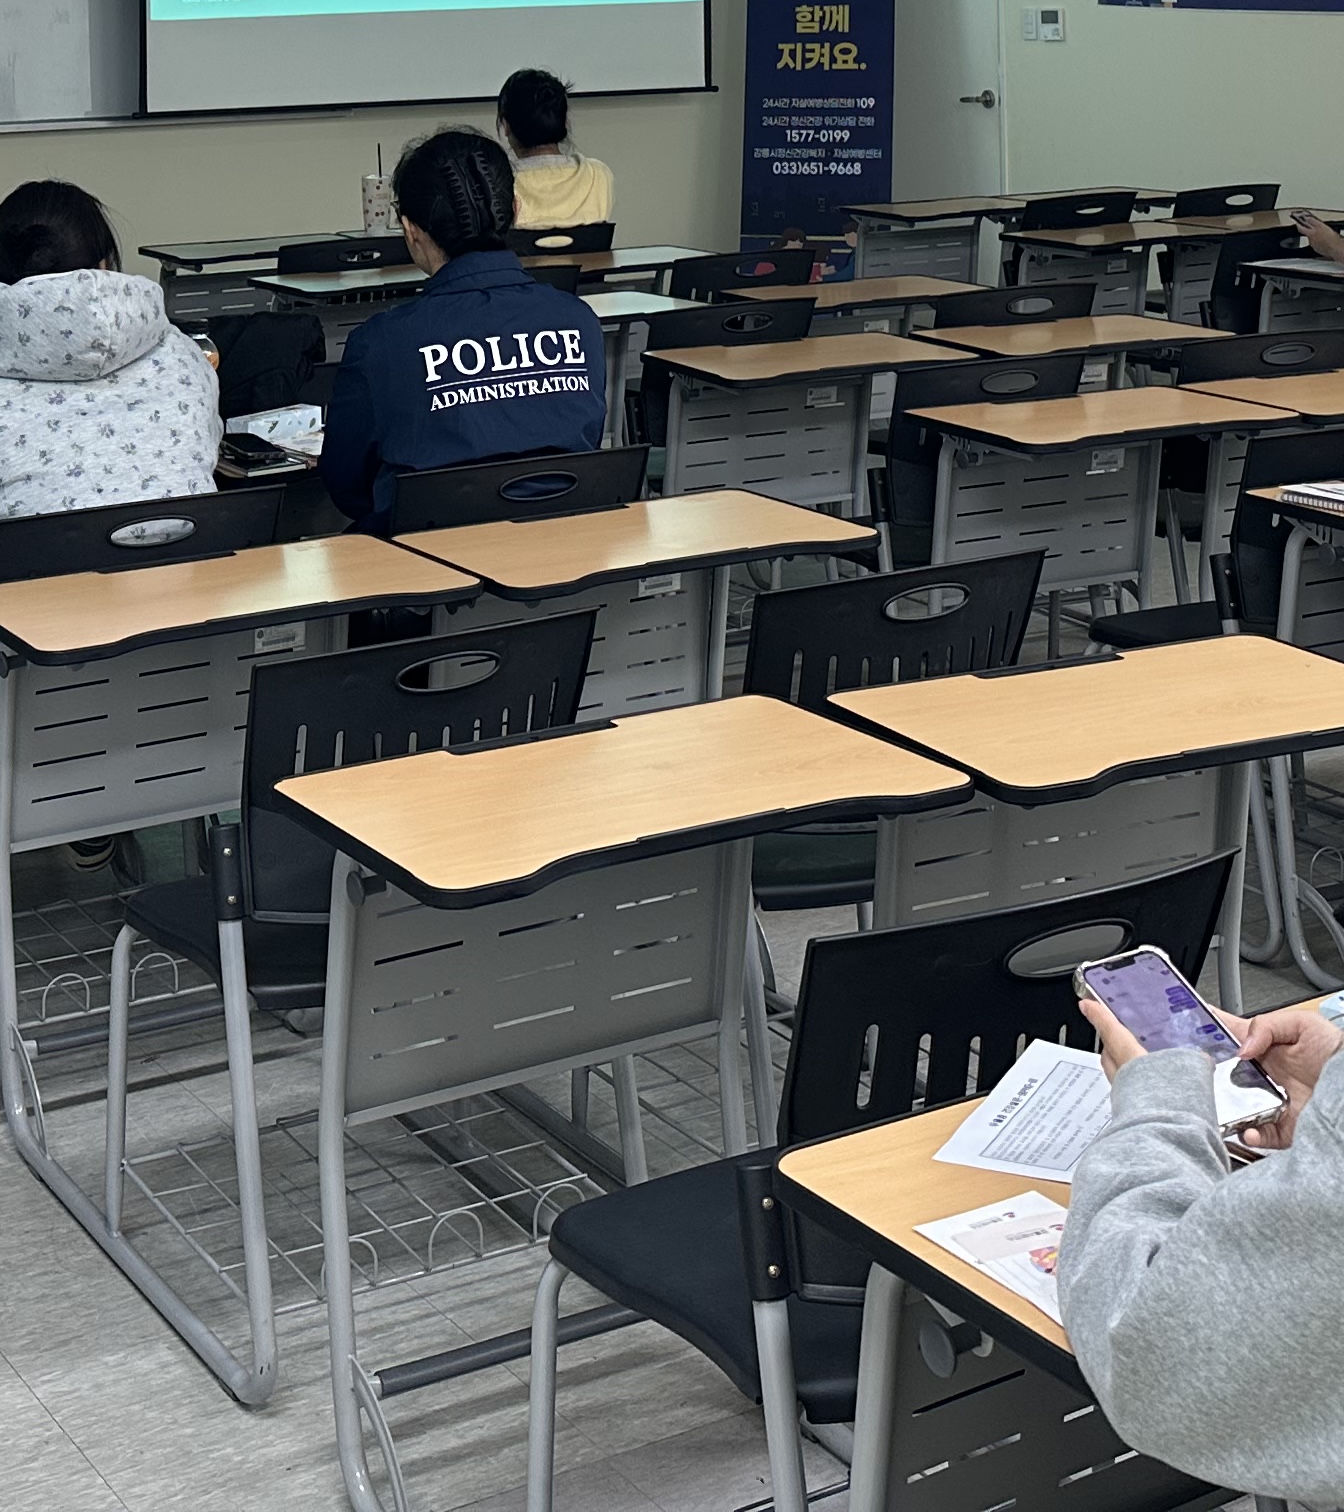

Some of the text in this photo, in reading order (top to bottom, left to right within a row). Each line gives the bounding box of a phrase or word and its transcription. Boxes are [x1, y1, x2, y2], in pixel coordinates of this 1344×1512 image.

[795, 5, 850, 33] 함께
[776, 42, 867, 71] 지켜요.
[762, 97, 789, 108] 24시간
[856, 97, 875, 108] 109
[762, 116, 789, 126] 24시간
[785, 129, 850, 142] 1577-0199
[772, 161, 862, 175] 033)651-9668
[418, 329, 586, 383] POLICE
[430, 376, 590, 412] ADMINISTRATION
